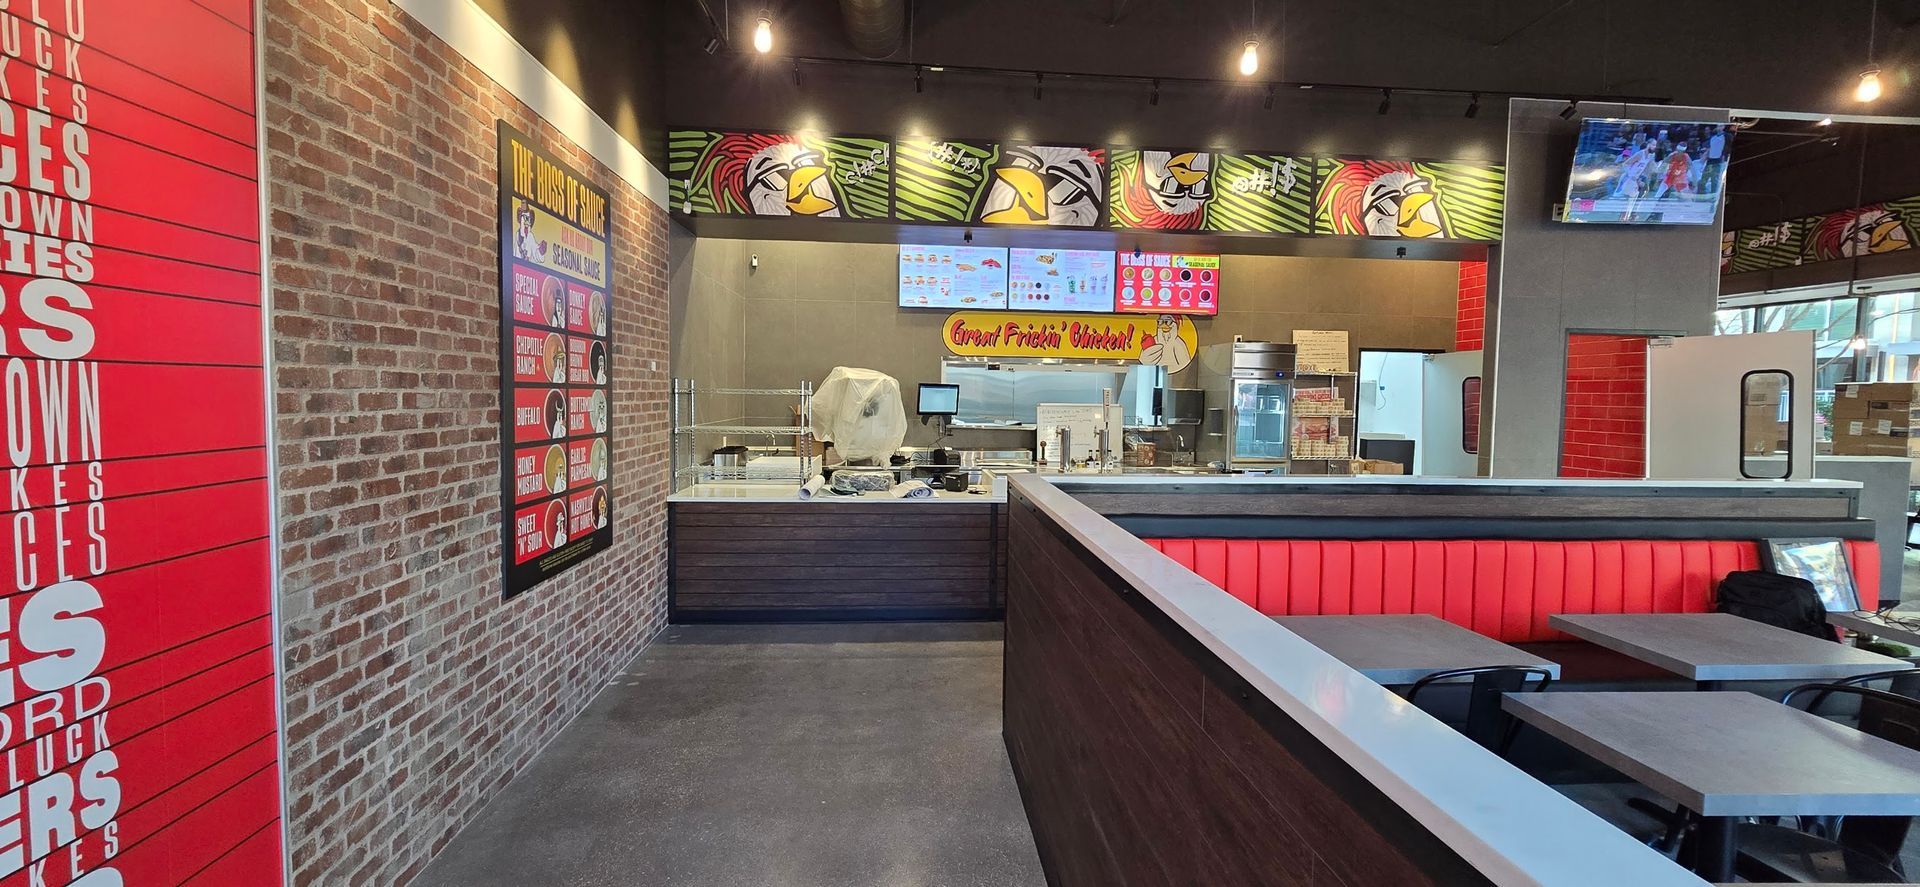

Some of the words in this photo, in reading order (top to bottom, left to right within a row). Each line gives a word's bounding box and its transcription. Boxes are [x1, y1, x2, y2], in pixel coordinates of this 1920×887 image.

[511, 138, 534, 201] THE
[536, 155, 565, 217] BOSS
[566, 175, 578, 223] OF
[579, 184, 605, 238] SAUCE
[0, 185, 93, 243] OWN
[0, 229, 94, 282] IES
[552, 242, 582, 274] SEASONAL
[584, 256, 600, 281] SAUCE
[515, 272, 539, 297] SPECIAL
[0, 278, 95, 360] S
[515, 293, 534, 316] SAUCE
[516, 334, 543, 356] CHIPOTLE
[949, 318, 1002, 347] Great
[1003, 321, 1067, 351] Frickin'
[1069, 321, 1135, 352] Chicken!
[516, 355, 536, 375] RANCH
[5, 357, 101, 468] OWN
[516, 406, 541, 426] BUFFALO
[517, 455, 536, 476] HONEY
[10, 461, 104, 512] KES
[517, 473, 543, 497] MUSTARD
[517, 513, 536, 537] SWEET
[527, 530, 543, 554] SOUR
[14, 502, 107, 592] CES
[8, 711, 110, 791] LUCK
